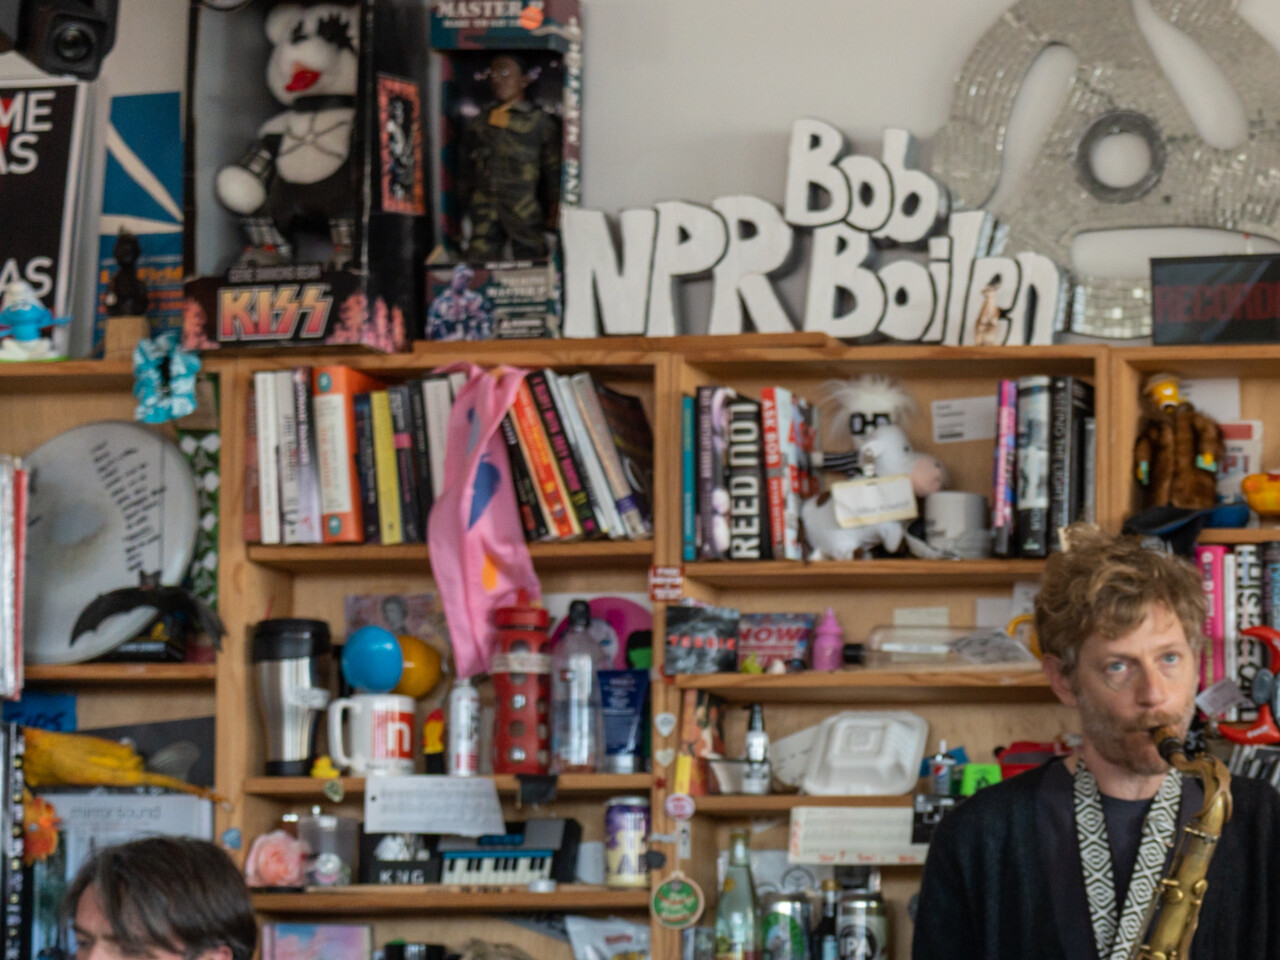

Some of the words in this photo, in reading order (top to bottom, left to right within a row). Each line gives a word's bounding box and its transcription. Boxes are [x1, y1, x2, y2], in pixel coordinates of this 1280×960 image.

[785, 118, 940, 243] Bob
[217, 283, 334, 342] KISS
[562, 195, 798, 339] NPR
[805, 210, 1062, 346] Boilen
[729, 475, 760, 559] REED
